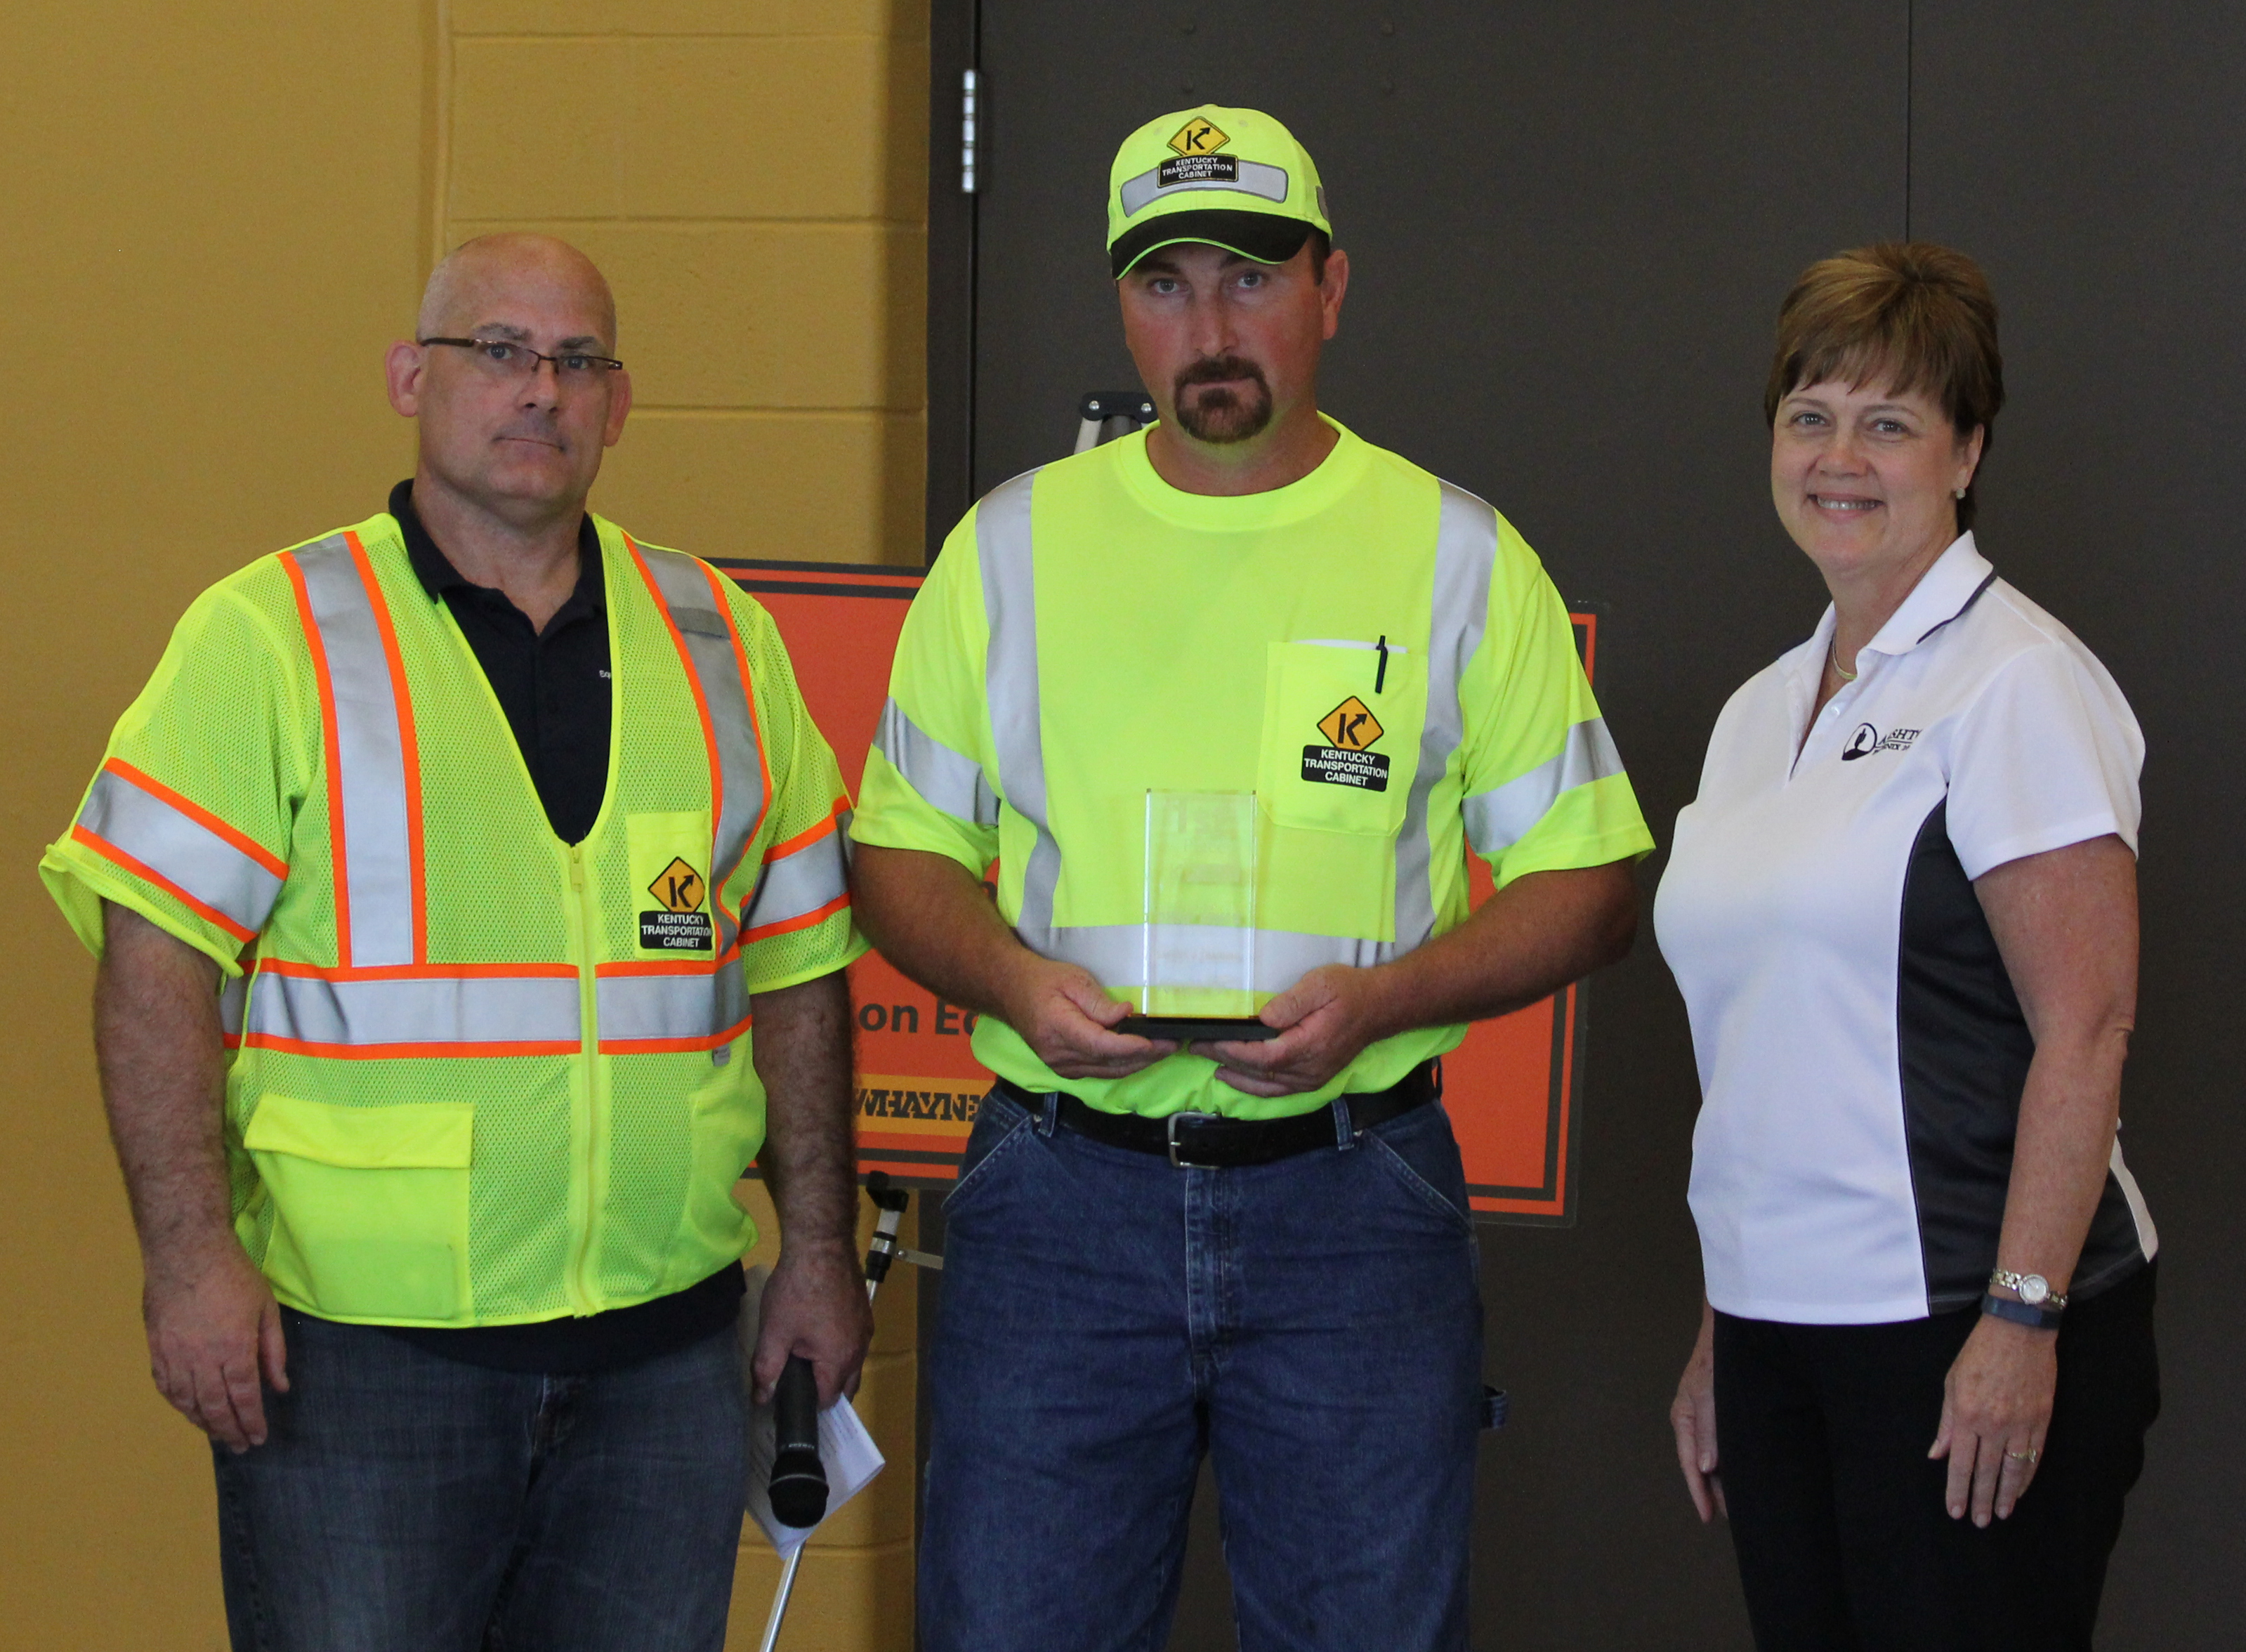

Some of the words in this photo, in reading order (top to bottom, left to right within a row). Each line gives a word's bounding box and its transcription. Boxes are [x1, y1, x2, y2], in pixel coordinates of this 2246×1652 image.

[1176, 157, 1218, 166] KENTUCKY
[1162, 163, 1233, 176] TRANSPORTATION
[1178, 170, 1212, 179] CABINET
[1321, 749, 1375, 765] KENTUCKY
[1304, 758, 1388, 779] TRANSPORTATION
[1325, 771, 1368, 786] CABINET
[657, 914, 704, 925] KENTUCKY
[663, 936, 700, 948] CABINET
[859, 1003, 919, 1033] on
